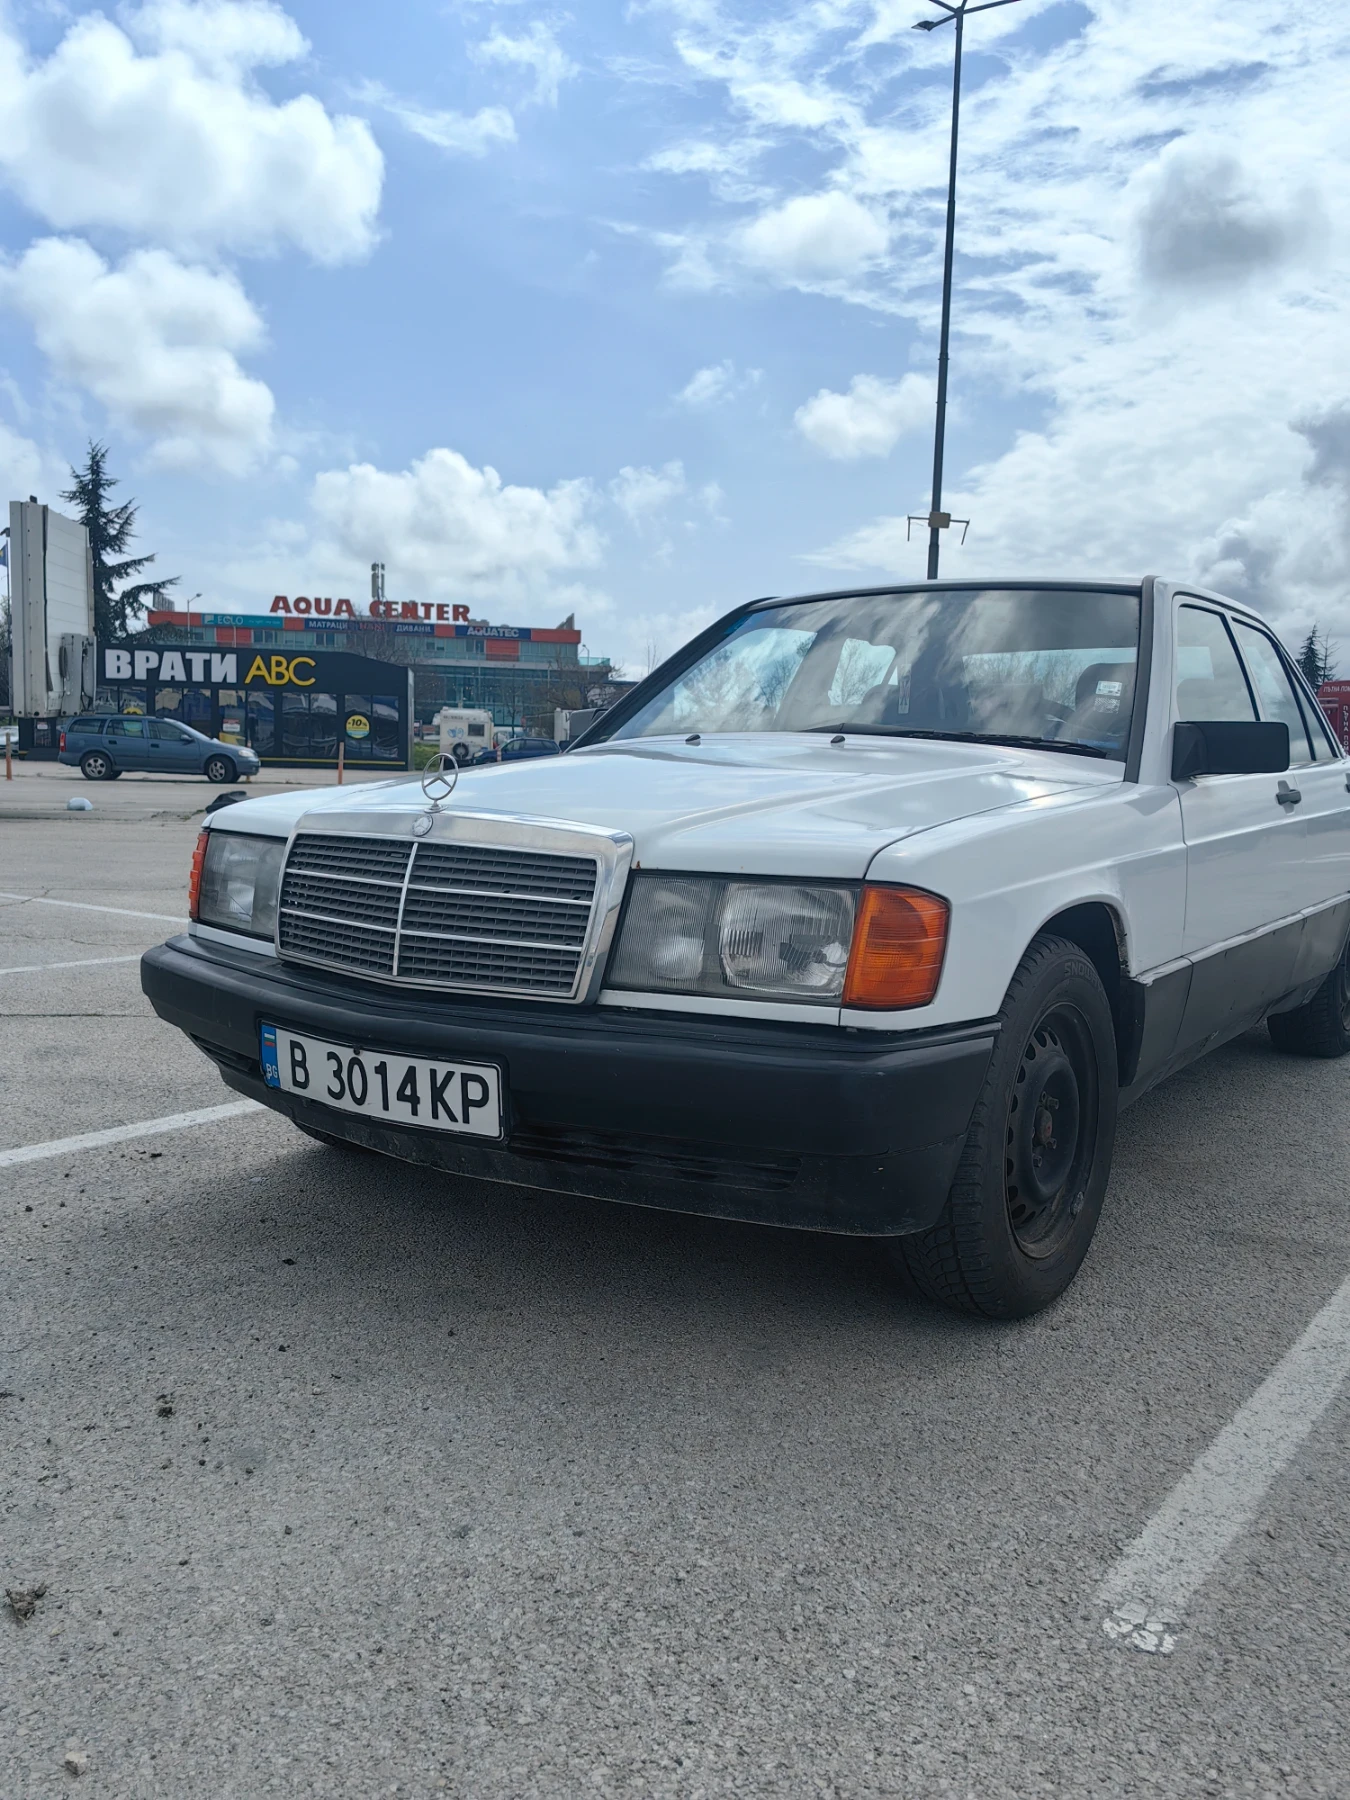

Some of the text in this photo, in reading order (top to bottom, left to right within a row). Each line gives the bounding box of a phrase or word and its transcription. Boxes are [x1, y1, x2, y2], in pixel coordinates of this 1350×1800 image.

[270, 595, 470, 622] AQUA CENTER
[308, 620, 348, 630] МАТРАЦИ
[396, 624, 431, 633] ДИВАНИ
[467, 626, 520, 637] AQUATEC
[105, 648, 237, 683] ВРАТИ
[265, 1063, 279, 1079] BG
[289, 1039, 310, 1090] B
